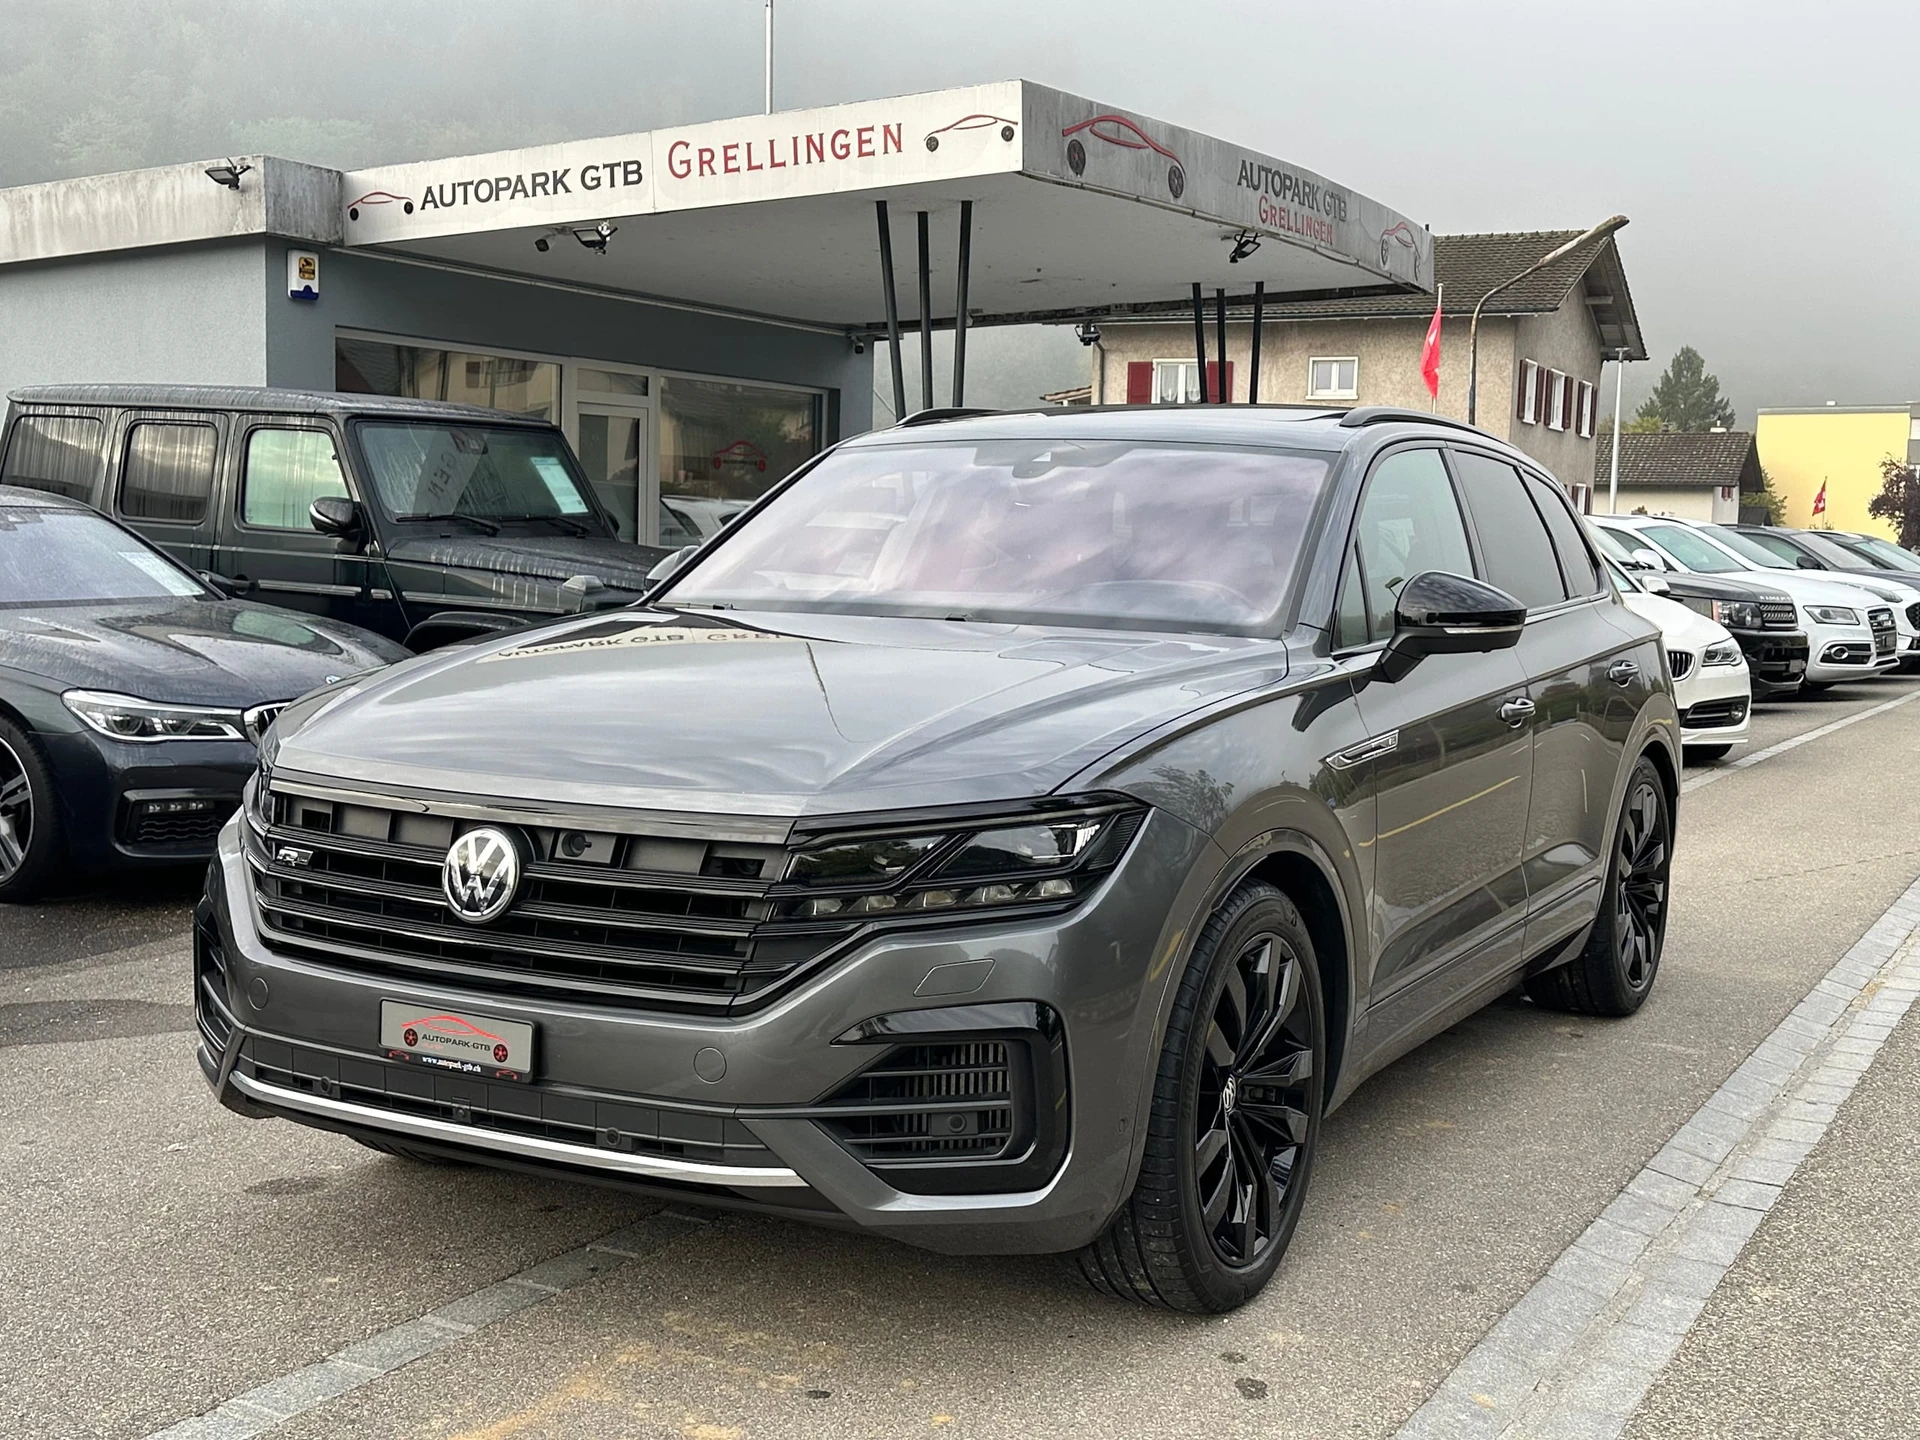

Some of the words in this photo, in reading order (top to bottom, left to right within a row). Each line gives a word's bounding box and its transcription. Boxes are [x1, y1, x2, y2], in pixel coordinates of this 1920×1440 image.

[668, 123, 903, 179] GRELLINGEN
[420, 168, 572, 210] AUTOPARK
[580, 160, 643, 190] GTB
[1237, 159, 1320, 212] AUTOPARK
[1323, 189, 1347, 222] GTB
[1258, 195, 1333, 245] GRELLINGEN
[421, 1033, 491, 1051] AUTOPARK-GTB
